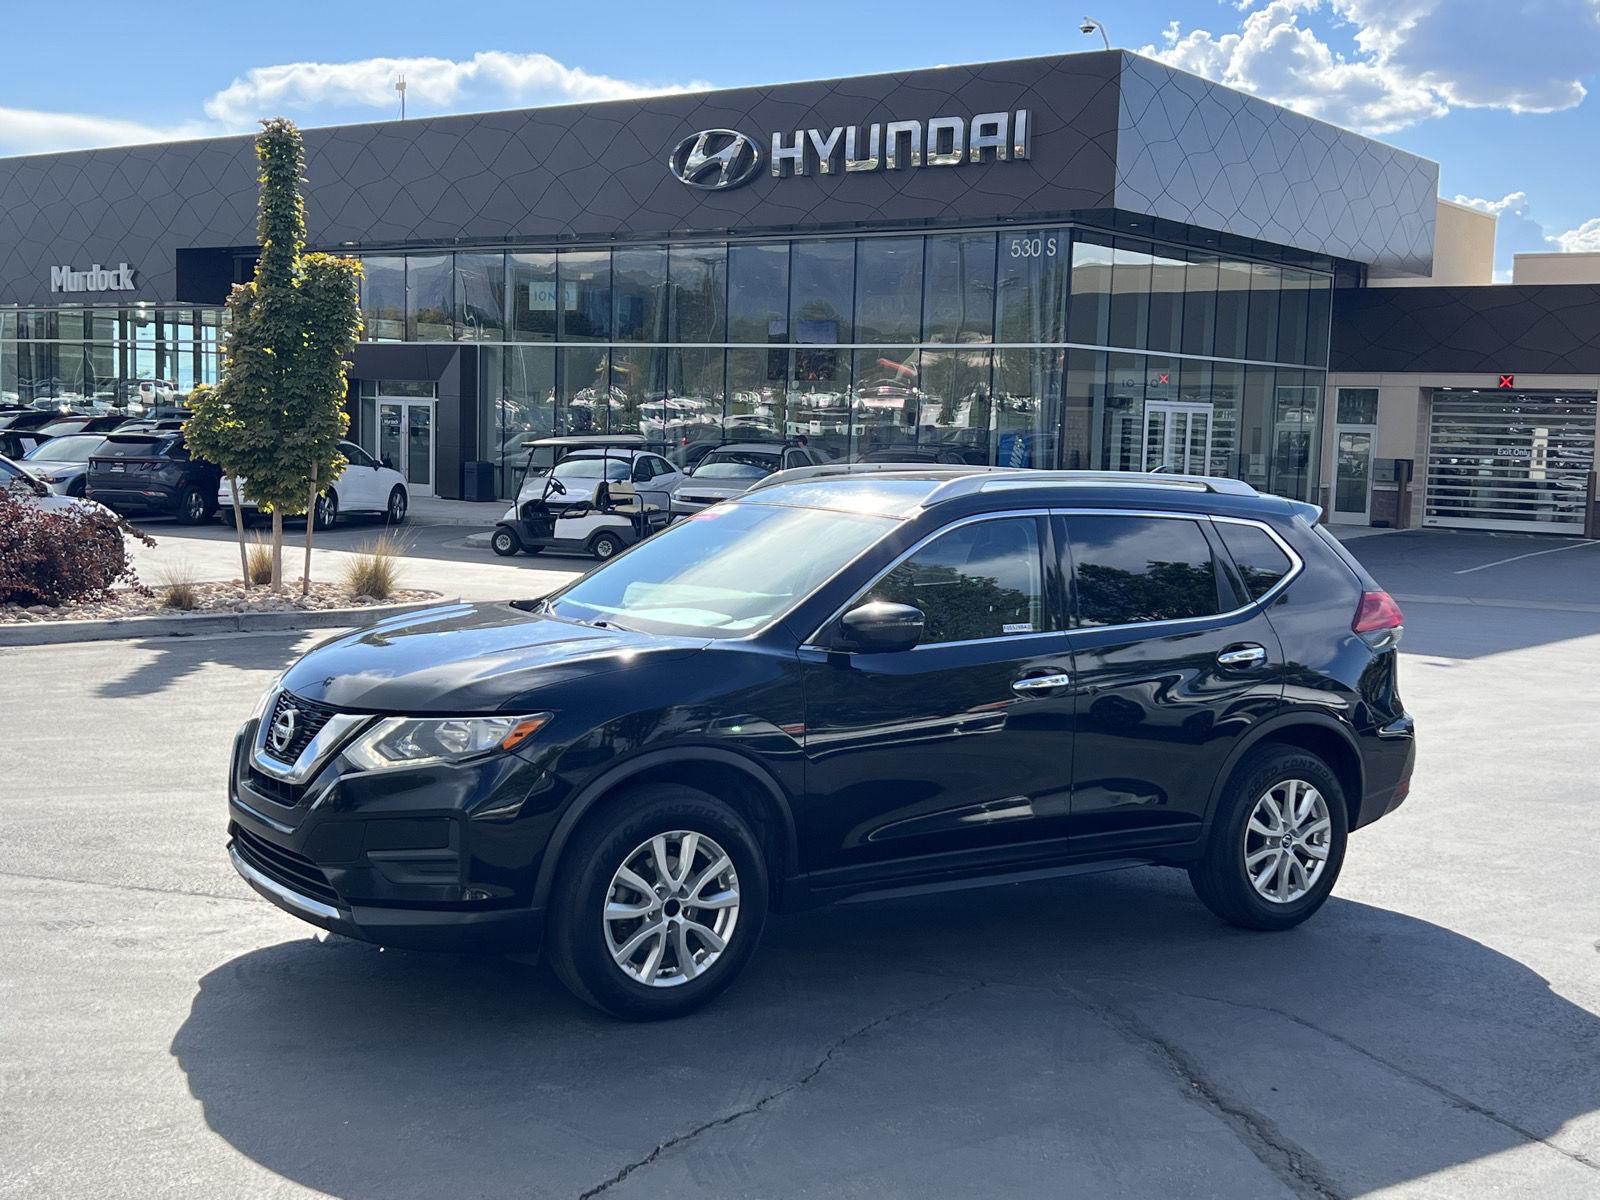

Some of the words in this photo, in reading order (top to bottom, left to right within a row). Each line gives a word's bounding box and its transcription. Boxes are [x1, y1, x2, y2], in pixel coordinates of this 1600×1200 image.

[771, 109, 1029, 177] HYUNDAI
[1011, 239, 1041, 257] 530
[1047, 238, 1057, 257] S
[50, 262, 136, 292] Murdock
[534, 291, 570, 301] ION
[1497, 447, 1512, 455] Exit
[1513, 447, 1530, 458] Only
